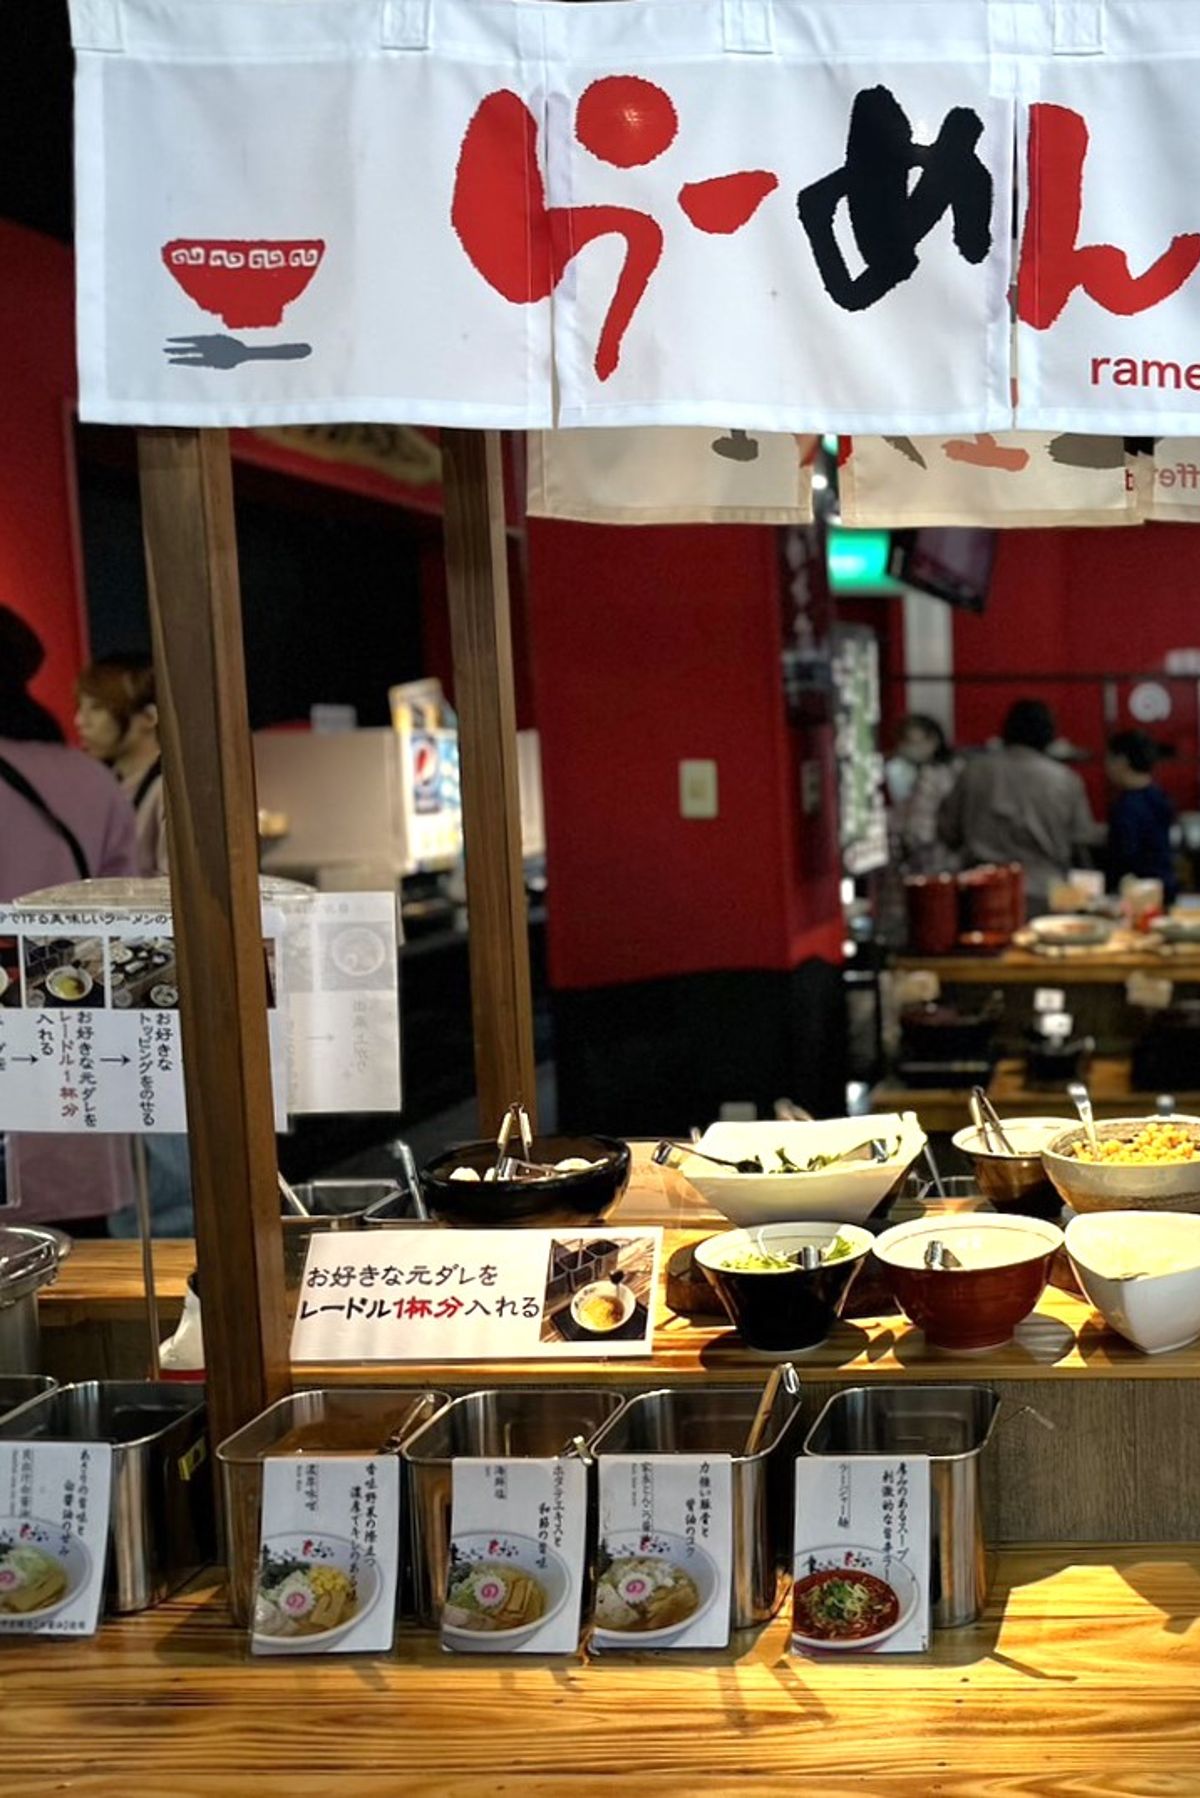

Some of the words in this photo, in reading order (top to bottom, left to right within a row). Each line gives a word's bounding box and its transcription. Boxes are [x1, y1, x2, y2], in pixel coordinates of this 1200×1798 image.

[0, 912, 173, 925] で作る美味しいラーメンの
[36, 1013, 54, 1056] 入れる
[156, 1013, 173, 1071] お好きな
[76, 1011, 96, 1127] お好きな元ダレを
[139, 1014, 154, 1126] トッピングをのせる
[306, 1264, 498, 1288] お好きな元ダレを
[300, 1295, 540, 1320] レードル1杯分入れる
